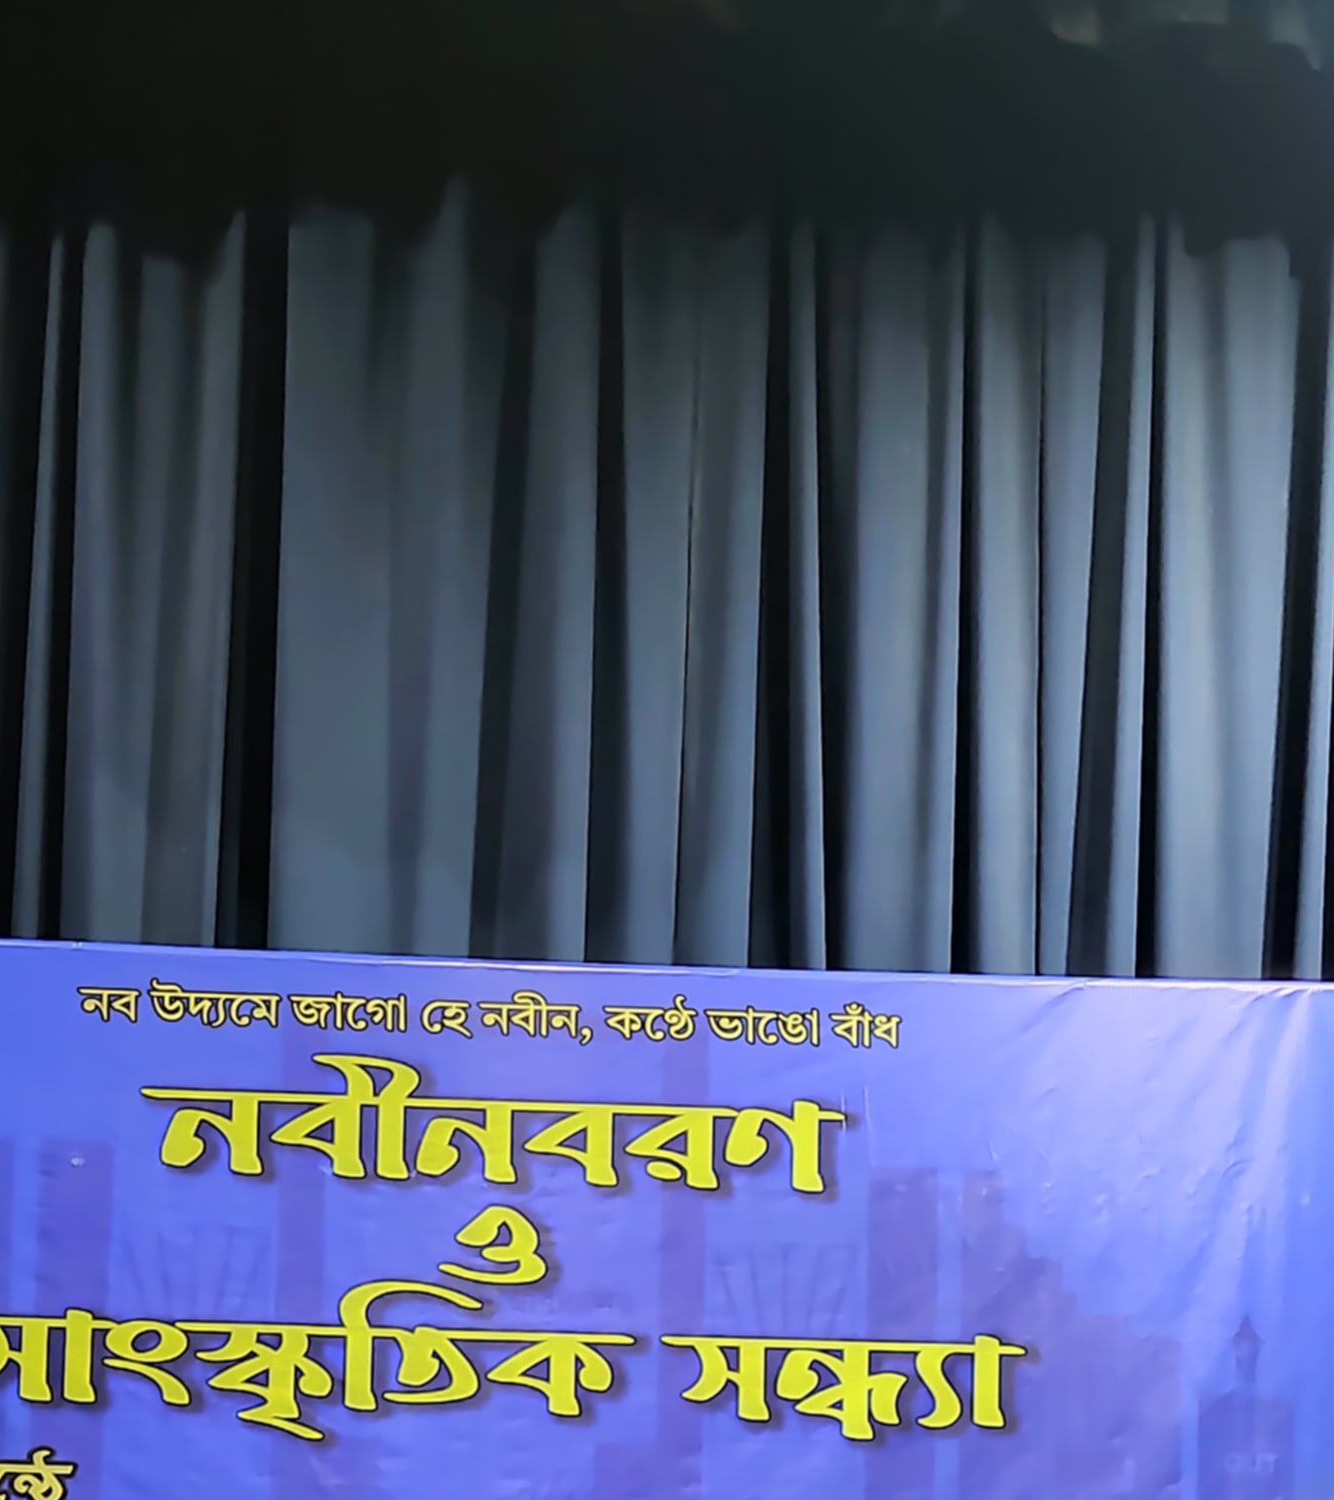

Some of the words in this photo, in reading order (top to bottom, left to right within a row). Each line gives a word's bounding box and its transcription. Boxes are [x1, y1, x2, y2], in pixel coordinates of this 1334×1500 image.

[79, 986, 140, 1022] নব
[149, 978, 280, 1028] উদ্যমে
[289, 992, 407, 1033] জাগো
[421, 999, 473, 1038] হে
[478, 990, 593, 1045] নবীন,
[705, 1005, 821, 1046] ভাঙো
[830, 1002, 902, 1048] বাঁধ
[140, 1053, 847, 1194] নবীনবরণ
[438, 1204, 550, 1285] ও
[661, 1332, 1028, 1440] সন্ধ্যা
